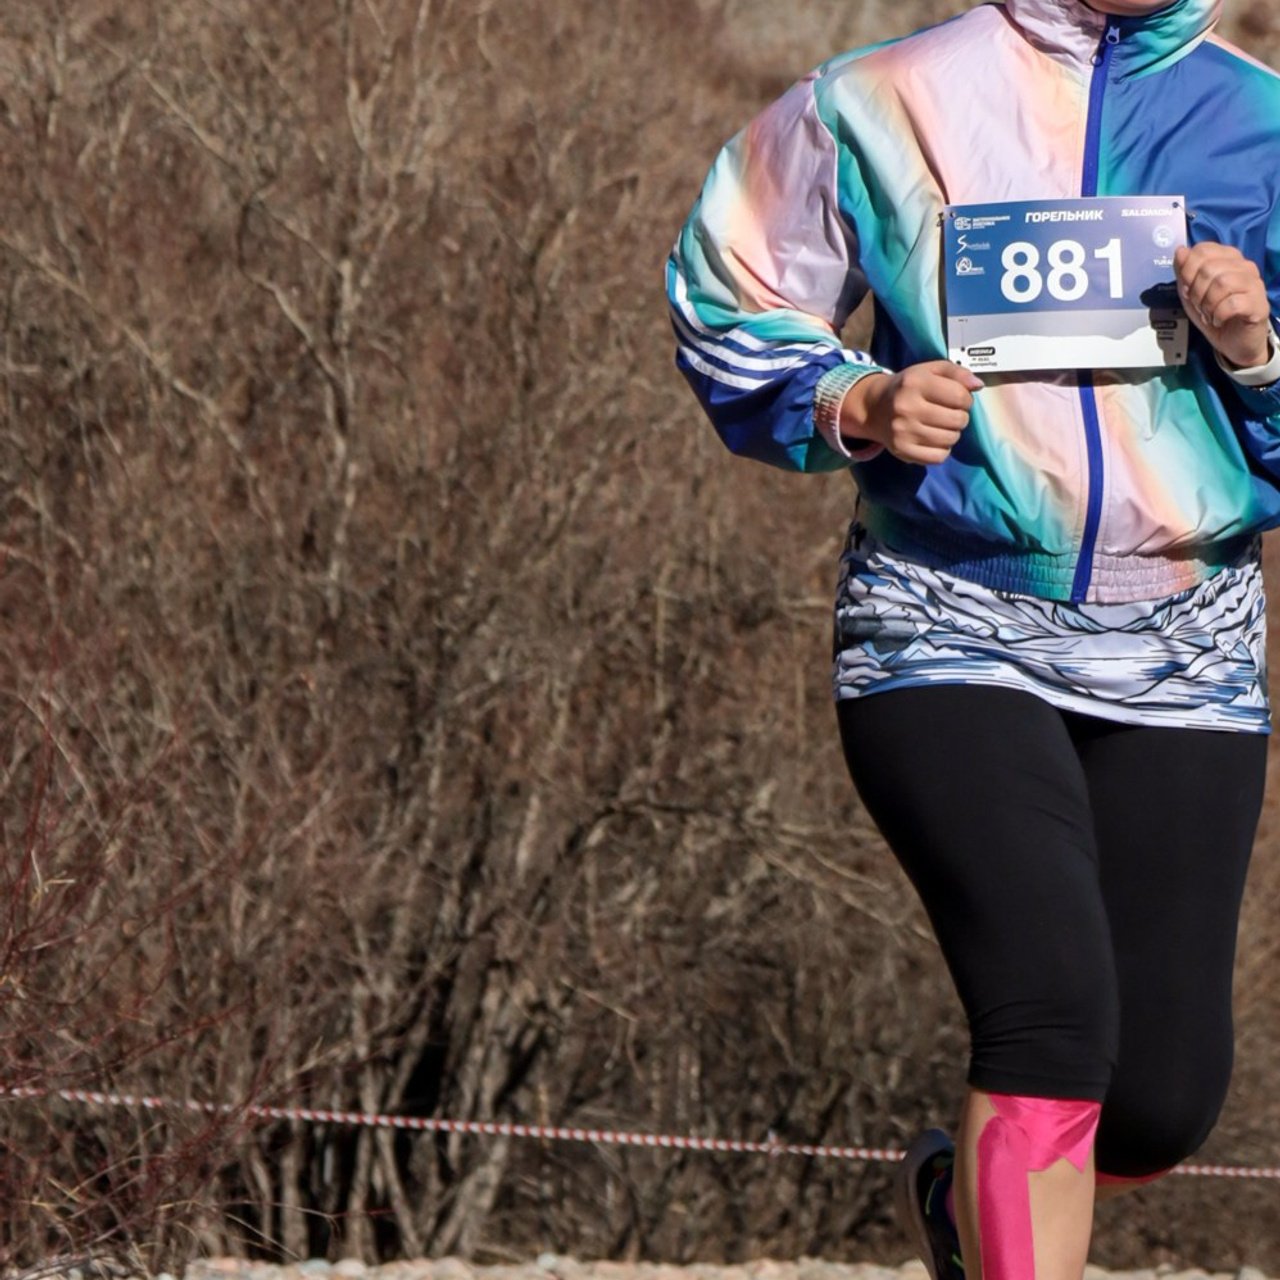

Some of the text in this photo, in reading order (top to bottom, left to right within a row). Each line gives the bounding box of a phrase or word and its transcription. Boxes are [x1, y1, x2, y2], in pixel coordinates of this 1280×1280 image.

[1025, 209, 1104, 223] ГОРЕЛЬНИК
[1121, 208, 1173, 217] SALOMON
[1000, 238, 1124, 303] 881
